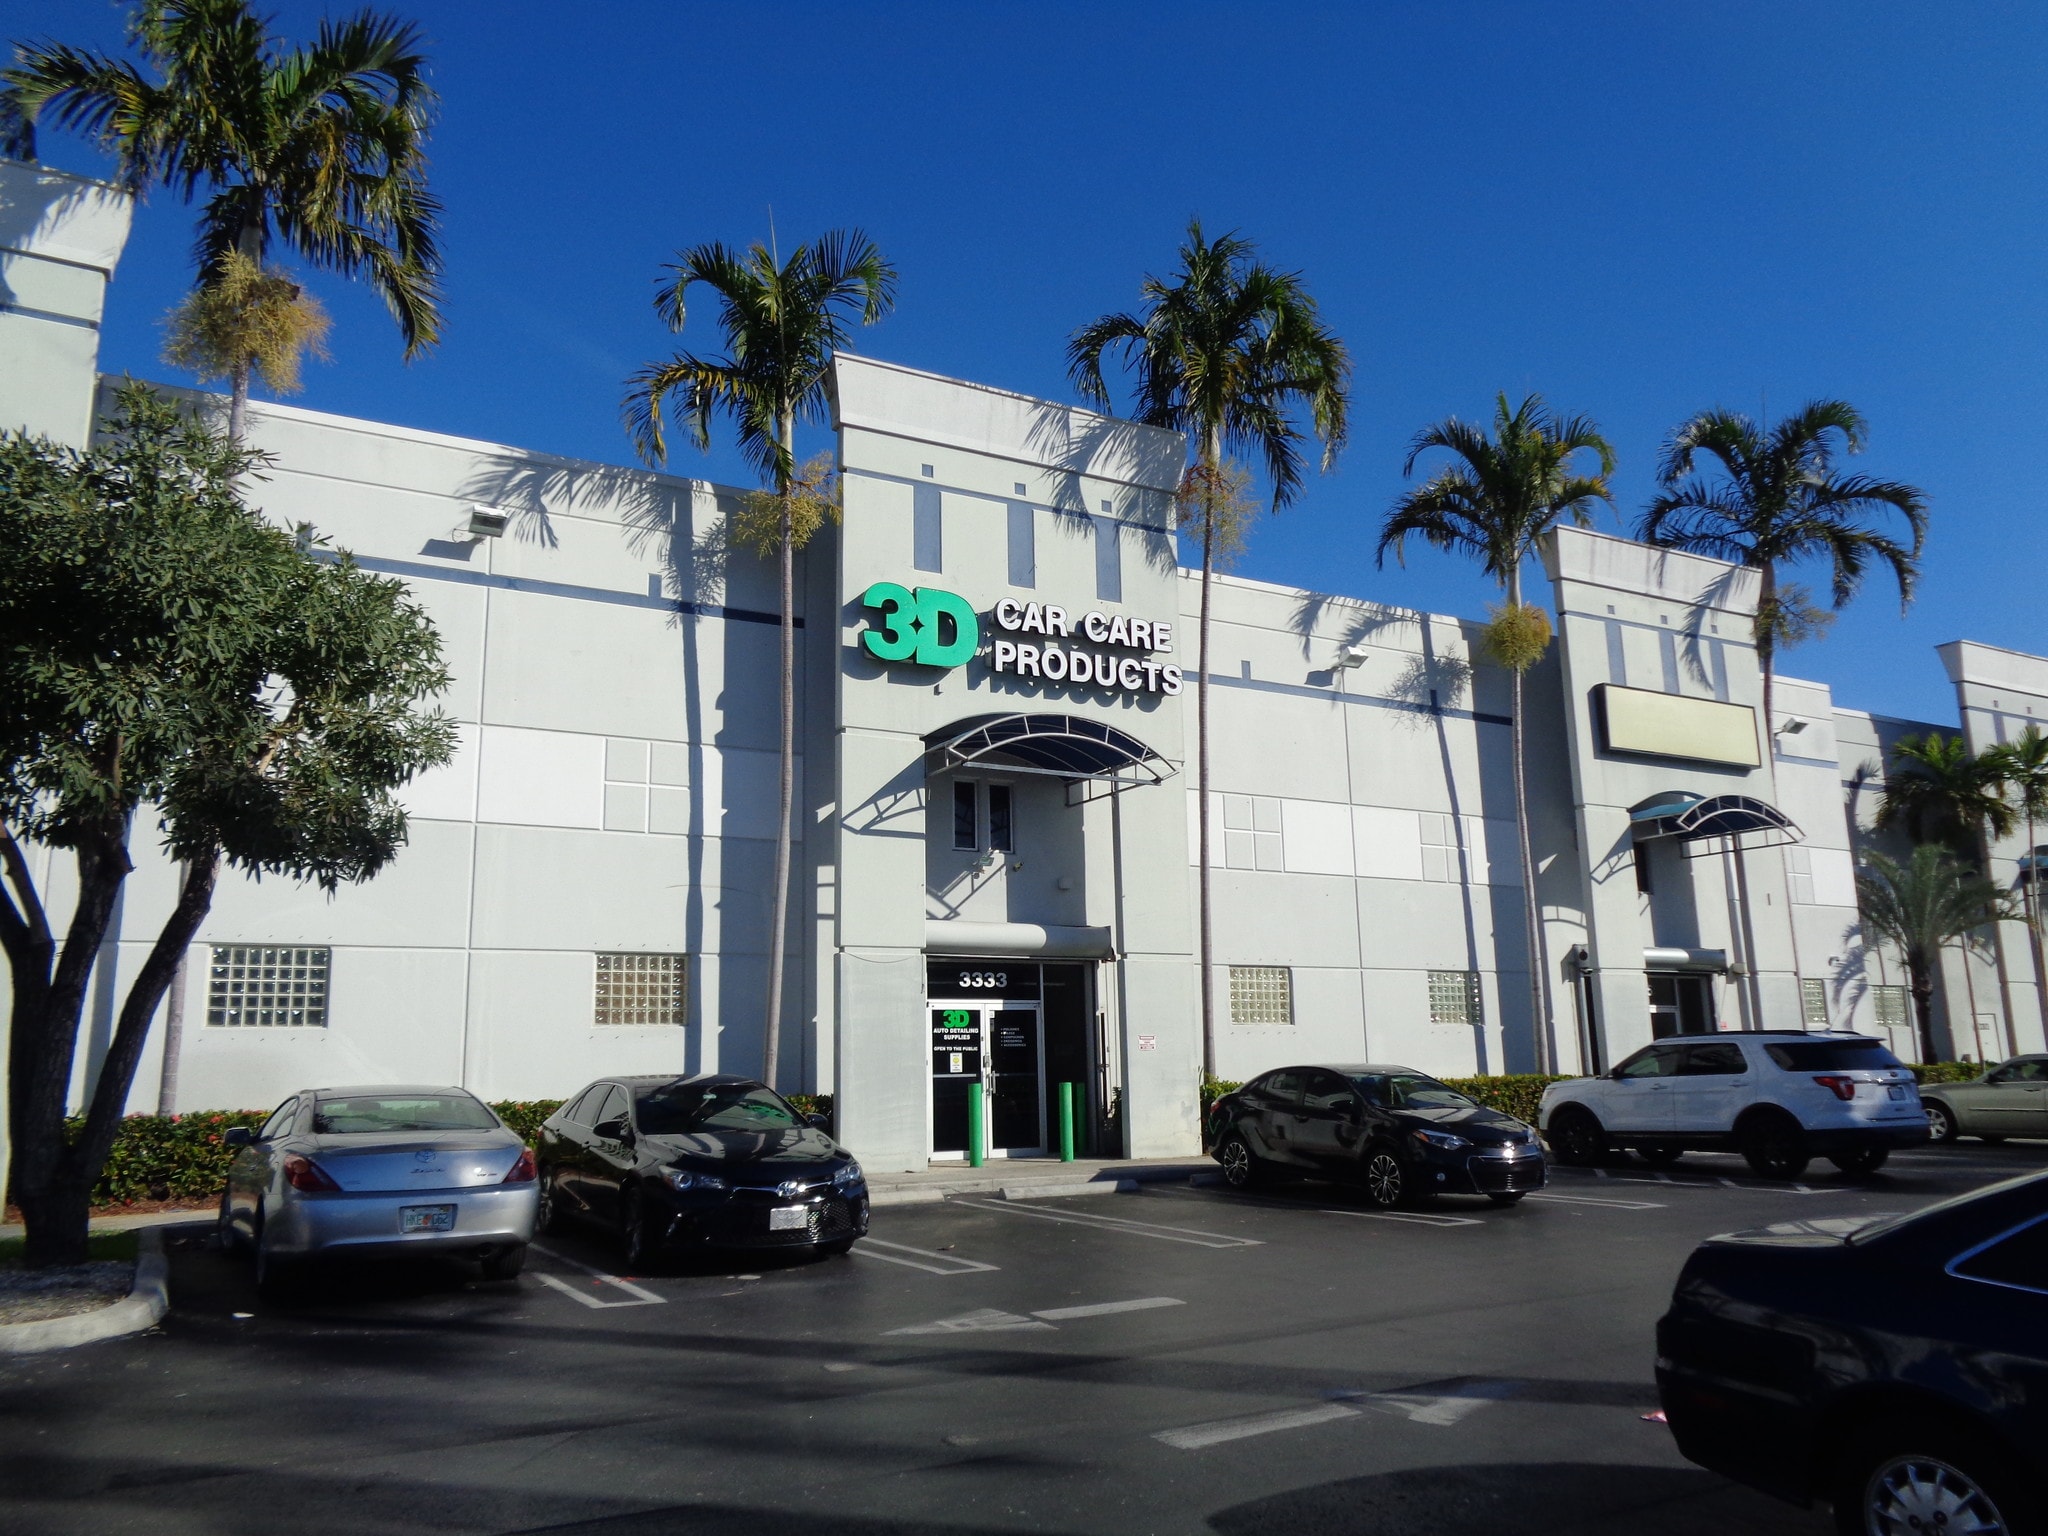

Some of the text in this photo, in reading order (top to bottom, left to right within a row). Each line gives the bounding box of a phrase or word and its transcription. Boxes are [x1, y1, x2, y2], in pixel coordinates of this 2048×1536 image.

[863, 581, 980, 668] 3D
[996, 597, 1173, 654] CAR CARE
[994, 640, 1184, 697] PRODUCTS
[959, 971, 1008, 988] 3333
[943, 1009, 970, 1028] 3D
